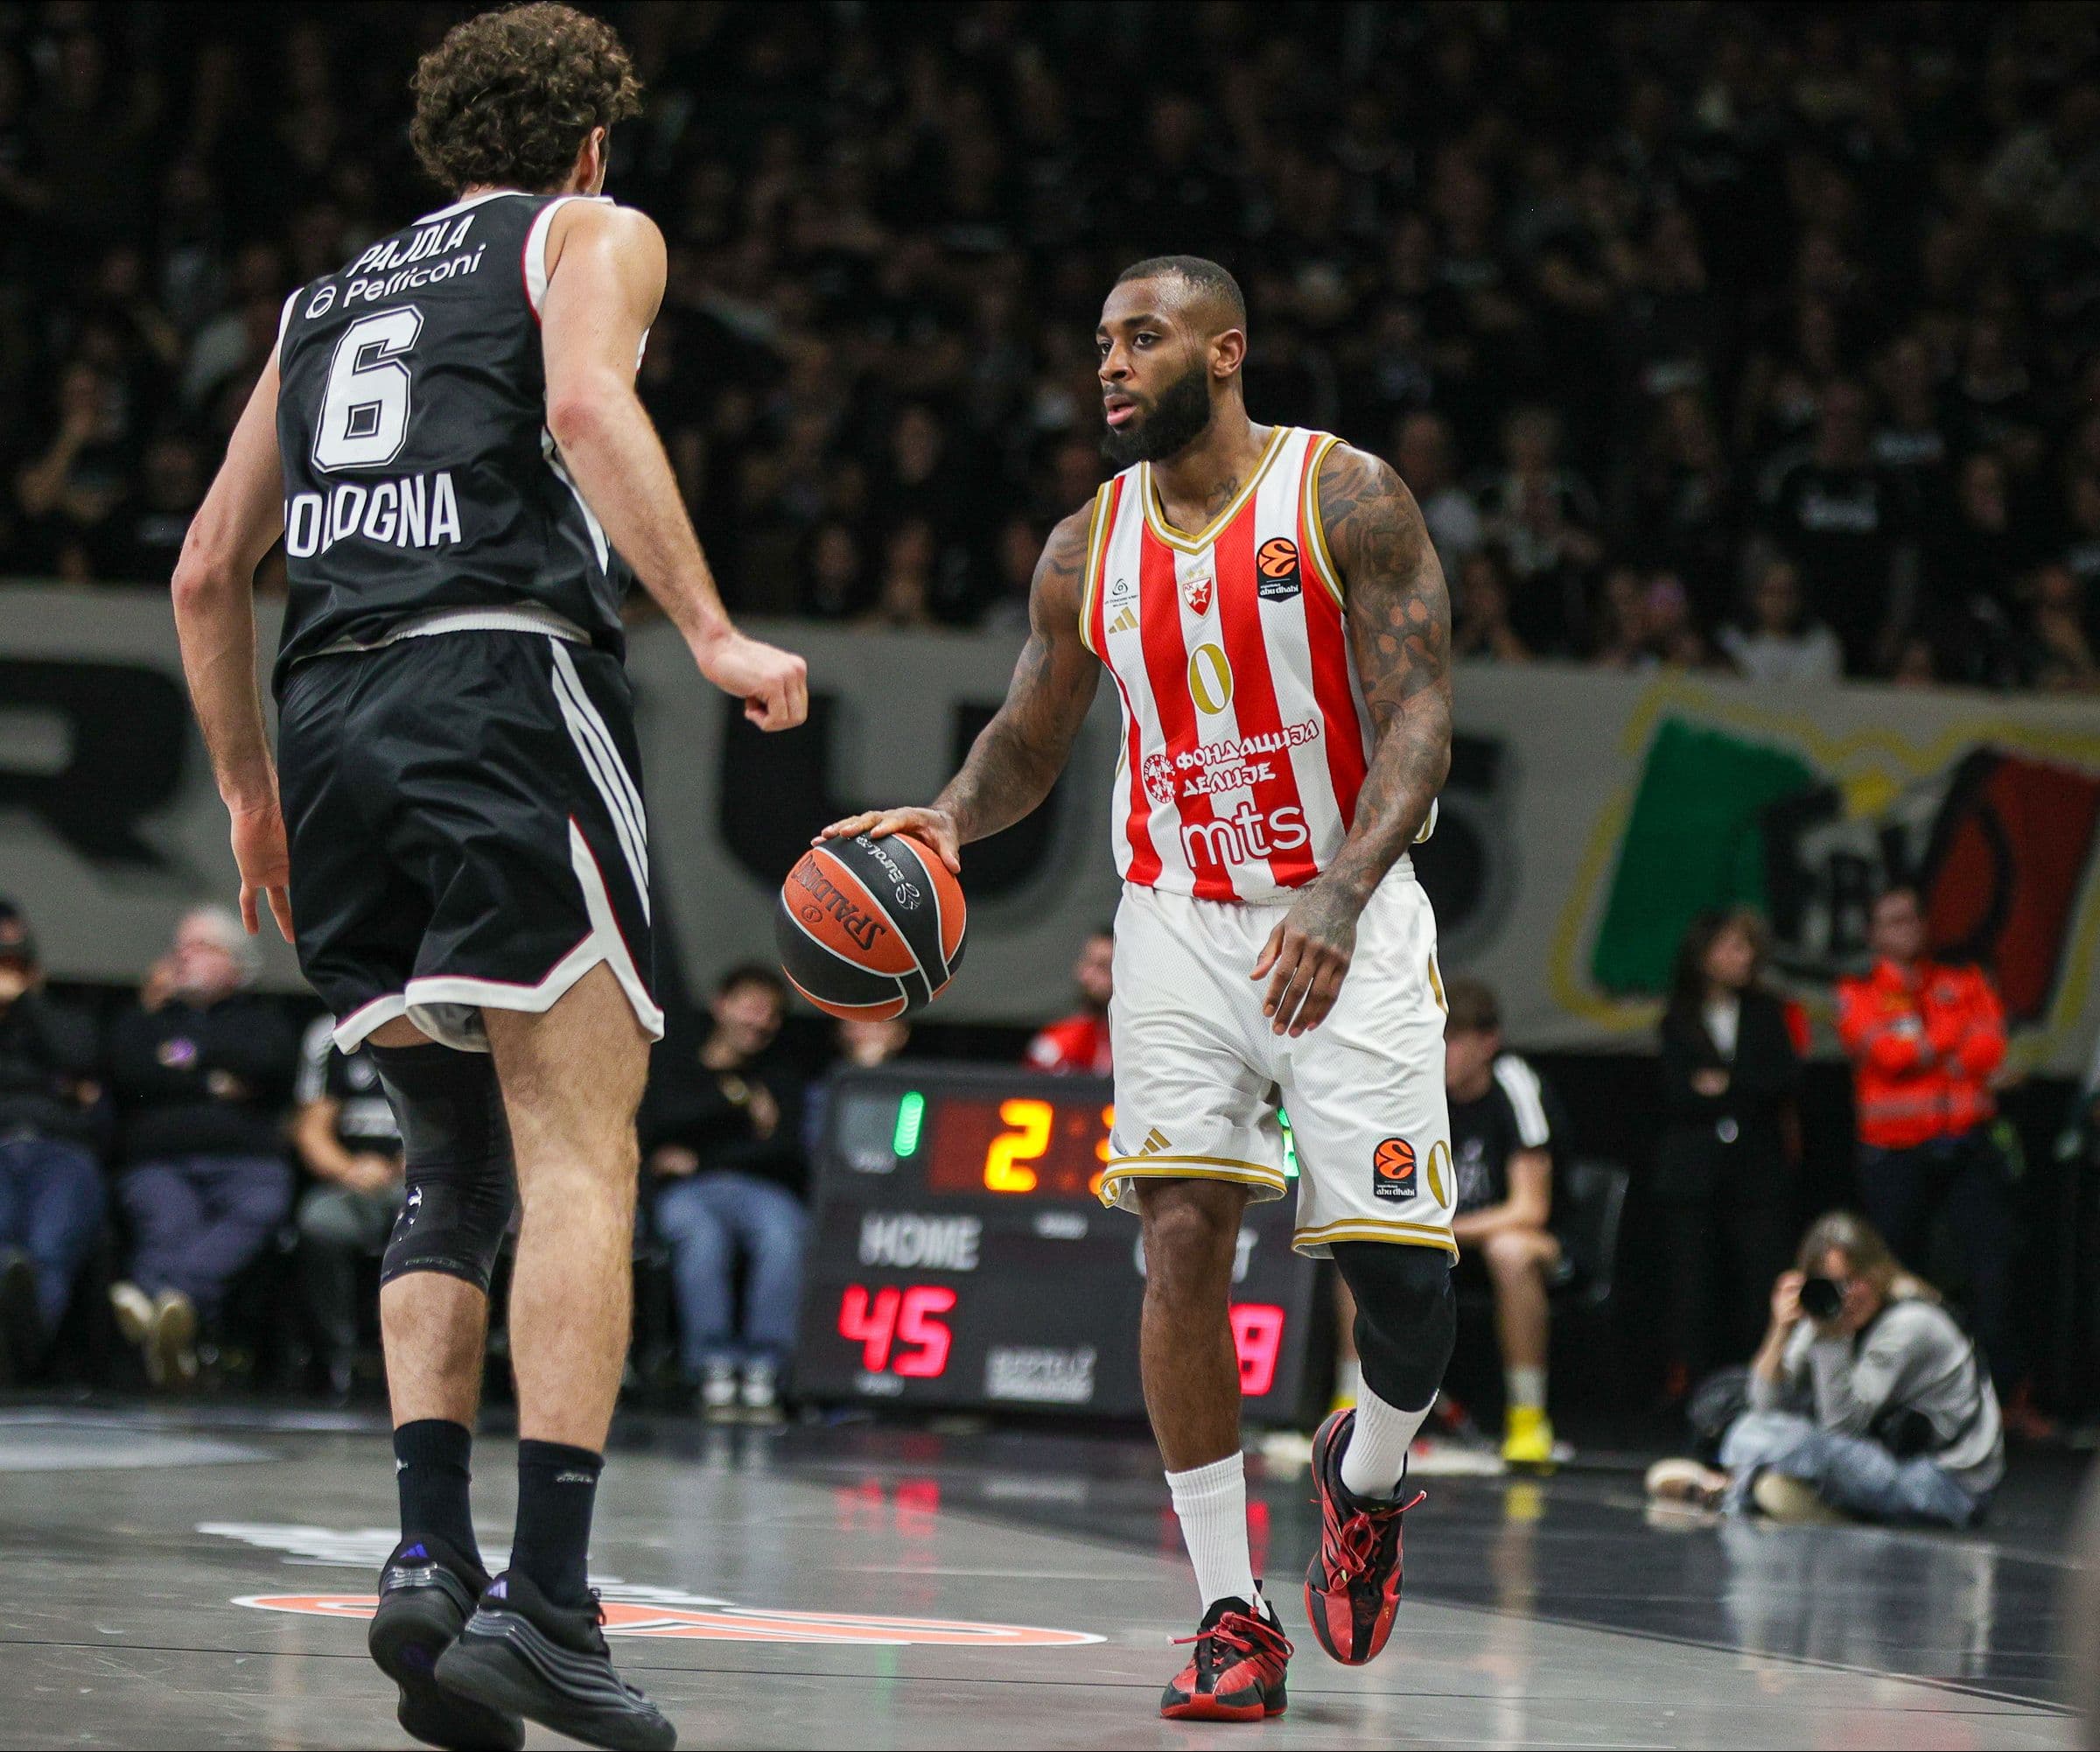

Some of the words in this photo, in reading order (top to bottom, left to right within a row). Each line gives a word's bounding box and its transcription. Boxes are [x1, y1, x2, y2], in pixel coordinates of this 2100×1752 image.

[342, 243, 486, 308] Pelliconi
[346, 214, 475, 278] PAJOLA
[312, 305, 424, 473] 6
[284, 472, 462, 557] OLOGNA
[1188, 643, 1234, 715] 0
[1181, 803, 1308, 868] mts
[860, 1213, 982, 1270] HOME
[839, 1284, 957, 1378] 45
